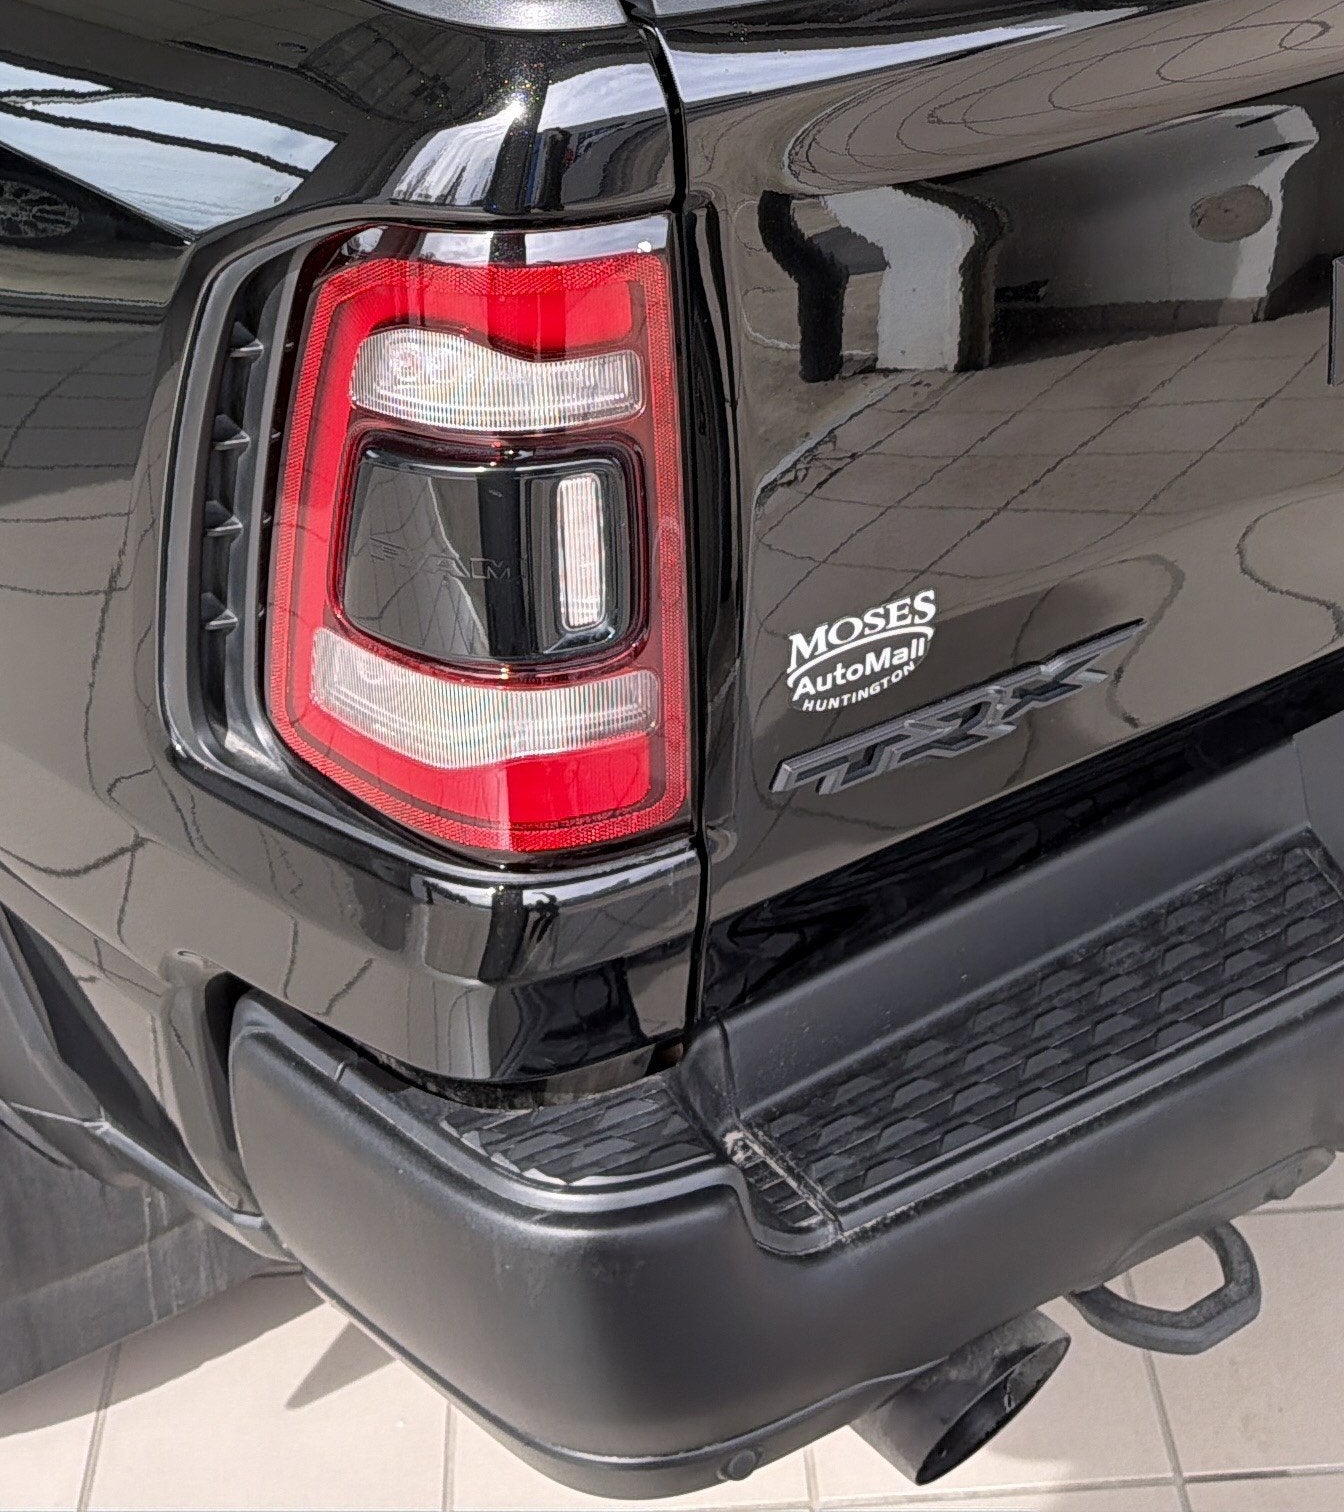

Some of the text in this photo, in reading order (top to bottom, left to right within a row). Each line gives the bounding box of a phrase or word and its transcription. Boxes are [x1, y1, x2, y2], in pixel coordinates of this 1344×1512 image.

[787, 590, 936, 672] MOSES
[793, 638, 926, 701] AutoMall
[802, 661, 916, 712] HUNTINGTON
[769, 618, 1146, 795] TRX
